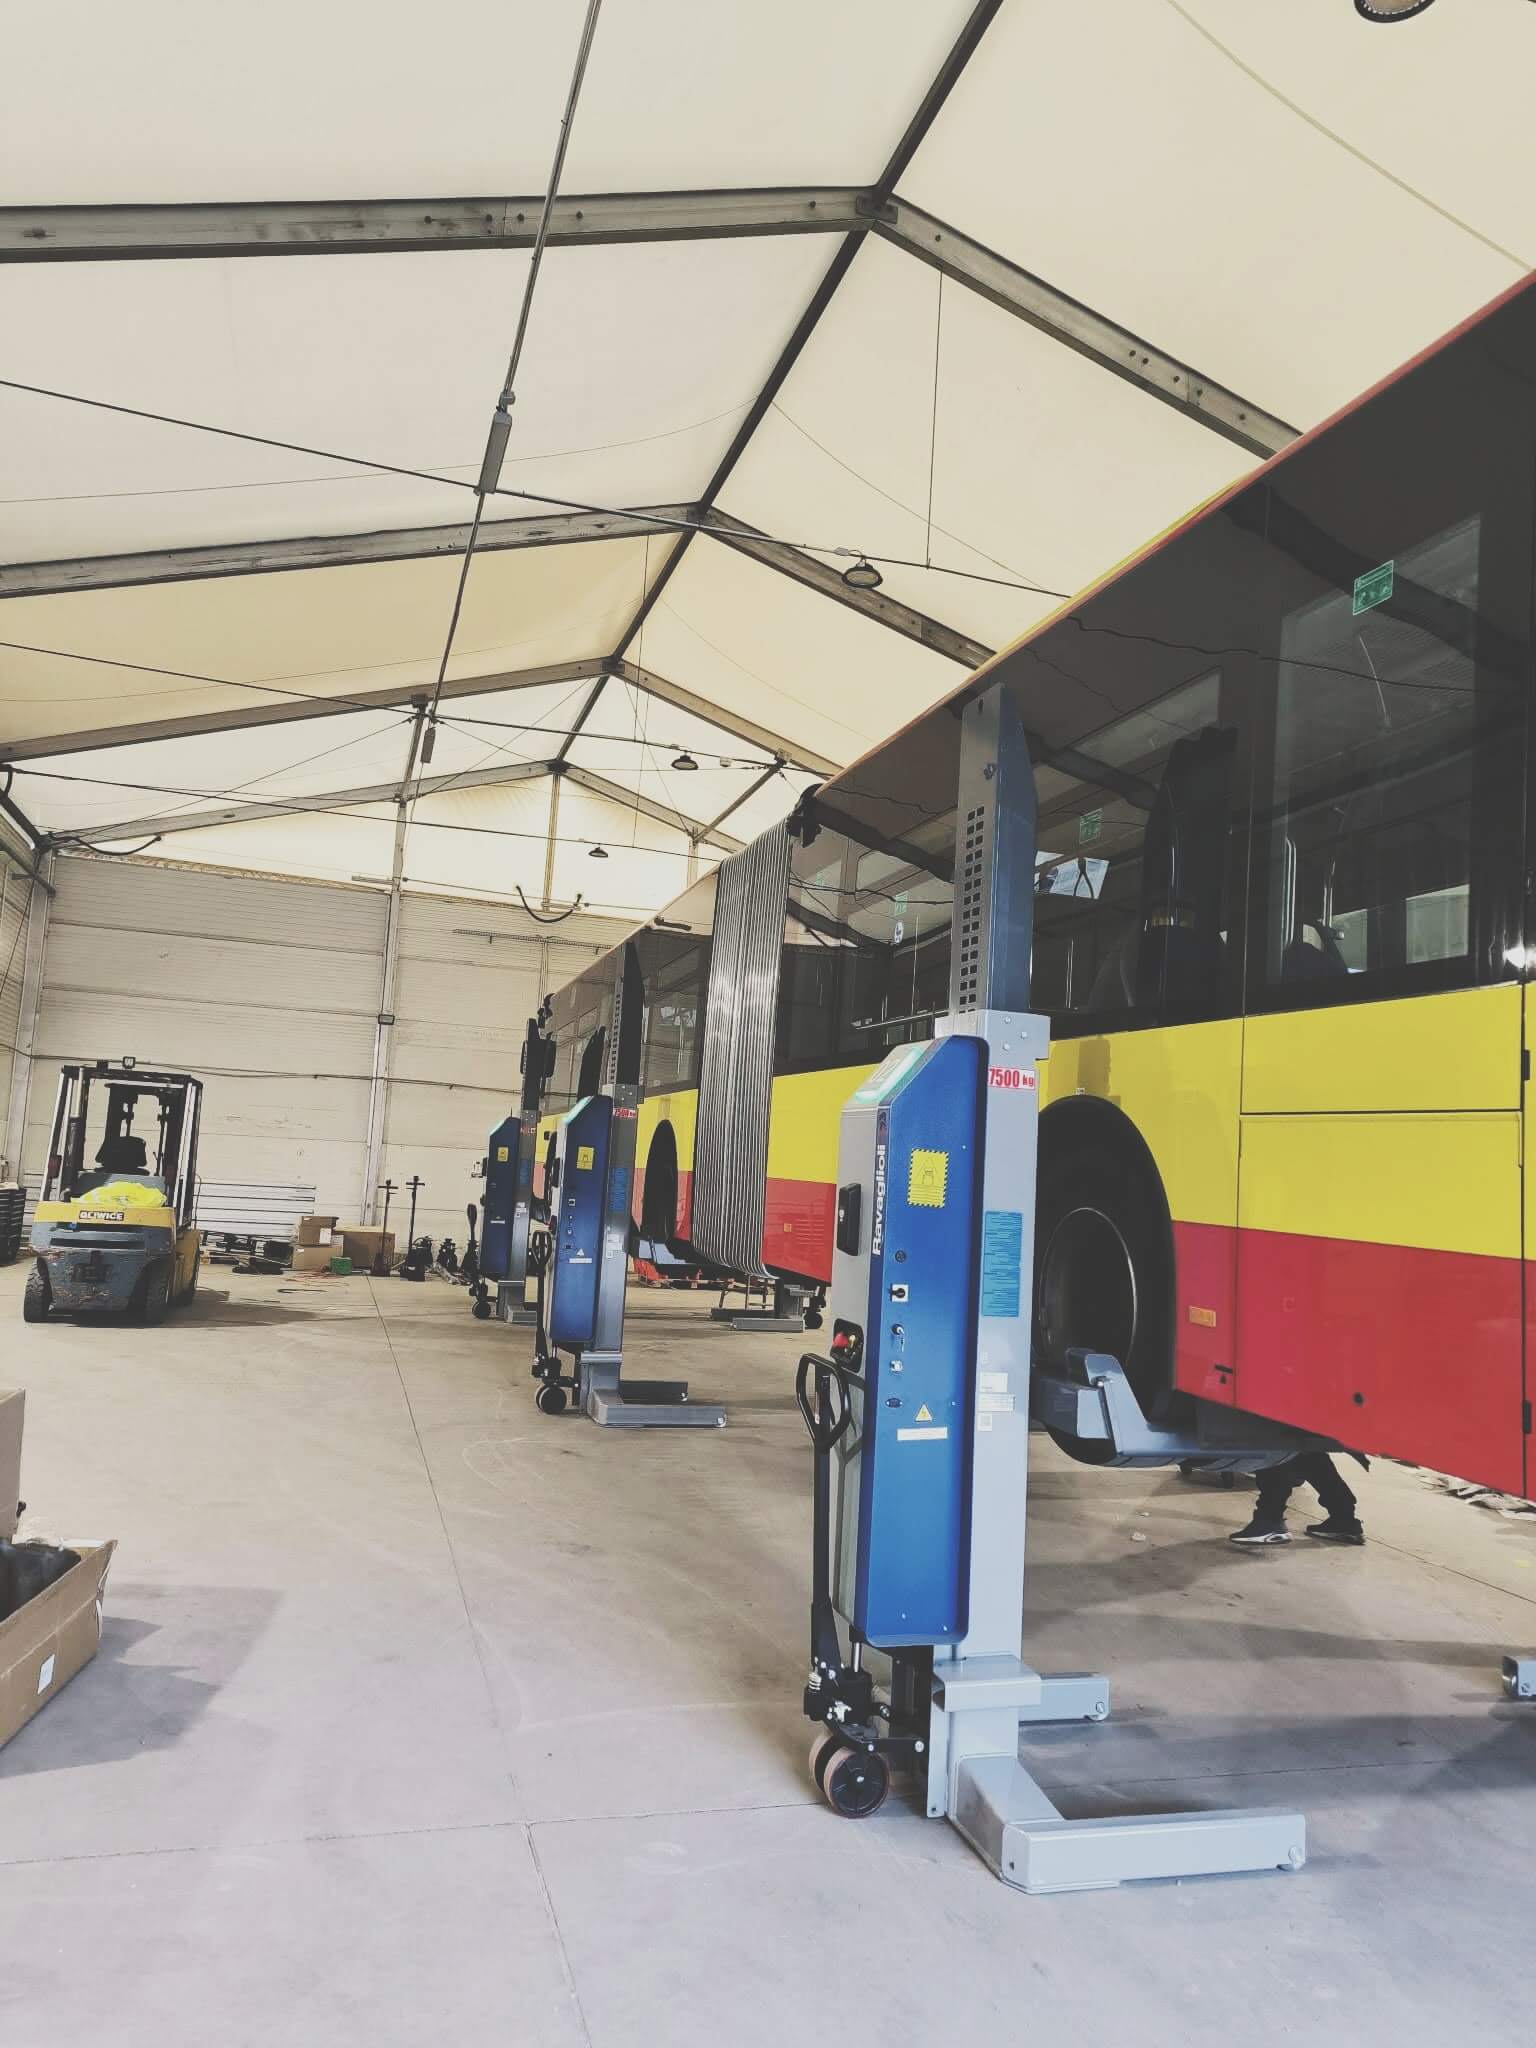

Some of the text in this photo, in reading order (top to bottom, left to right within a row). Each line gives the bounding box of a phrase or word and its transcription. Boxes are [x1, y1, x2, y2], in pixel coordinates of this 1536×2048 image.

[989, 1068, 1034, 1088] 7500 kg
[872, 1144, 886, 1255] Ravaglioli
